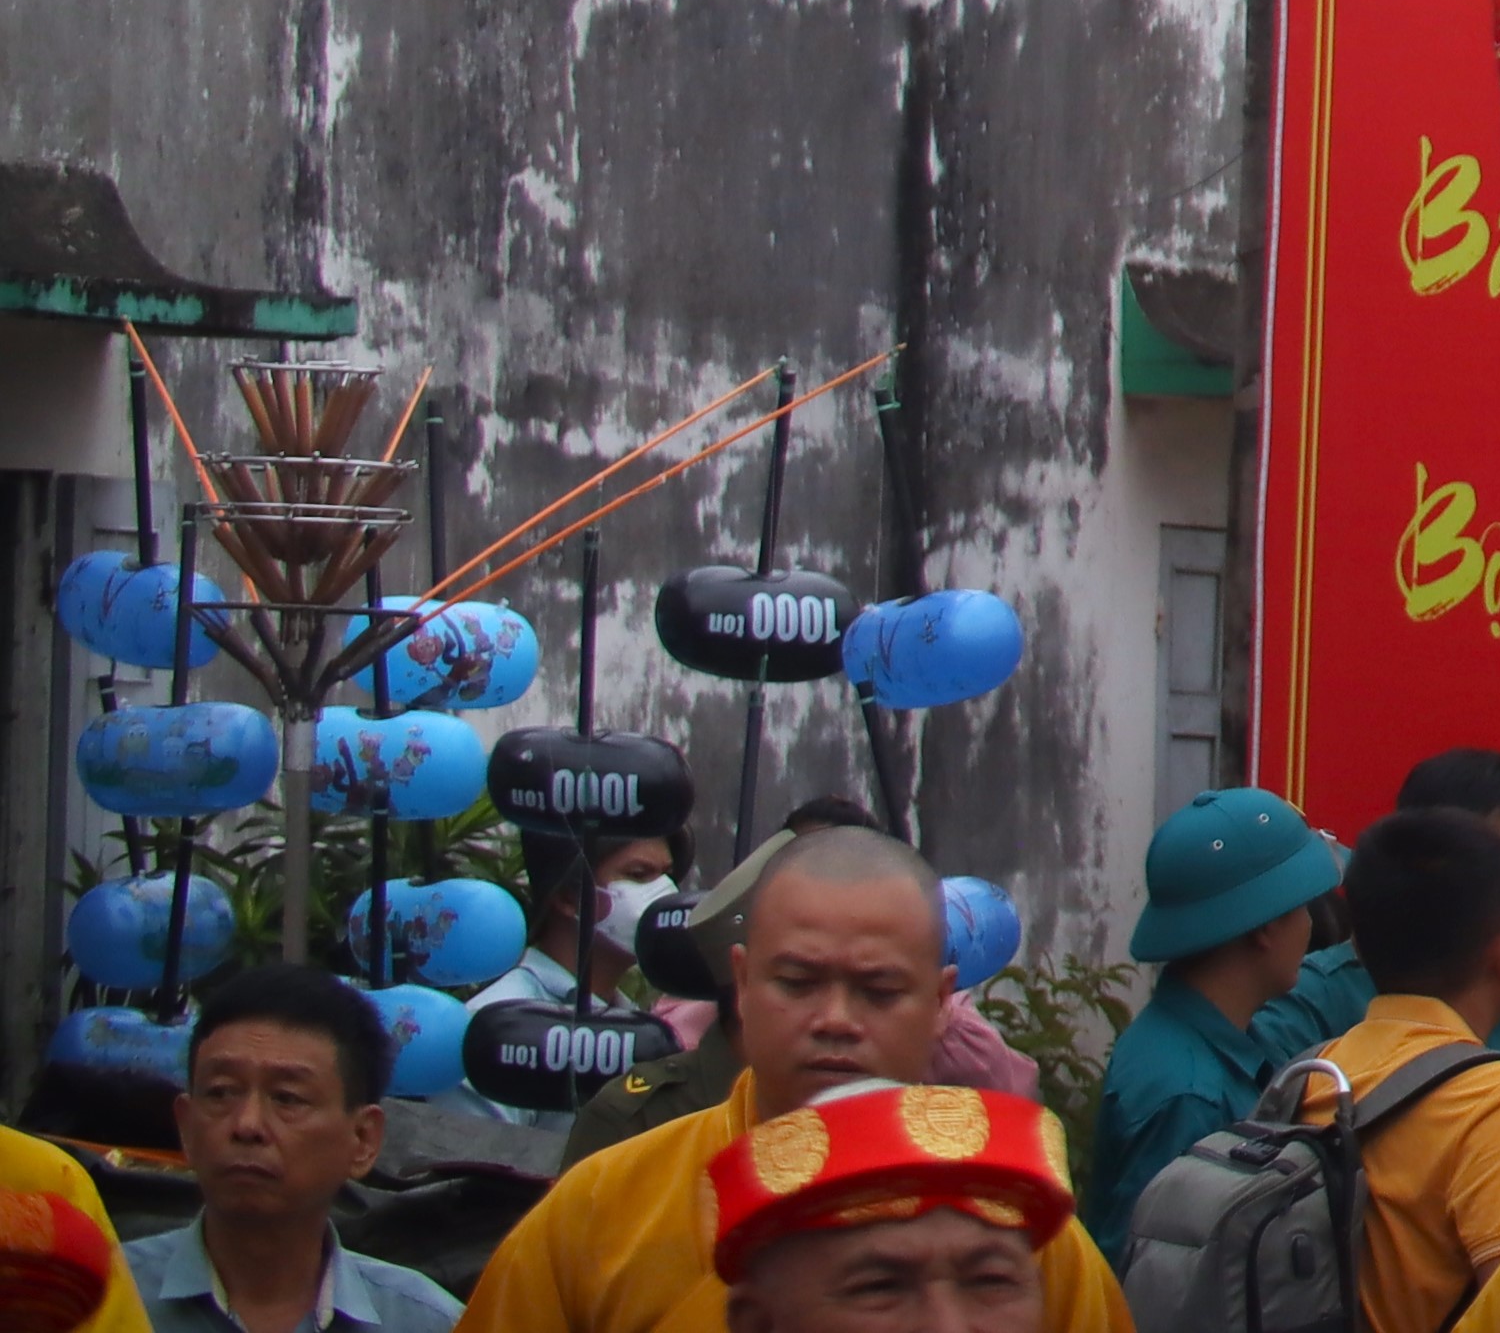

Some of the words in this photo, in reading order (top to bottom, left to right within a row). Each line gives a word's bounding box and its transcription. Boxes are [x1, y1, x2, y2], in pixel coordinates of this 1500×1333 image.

[708, 612, 746, 638] ton
[752, 592, 840, 645] 1000
[511, 787, 547, 810] ton
[552, 768, 645, 818] 1000
[501, 1043, 538, 1069] ton
[545, 1024, 637, 1075] 1000
